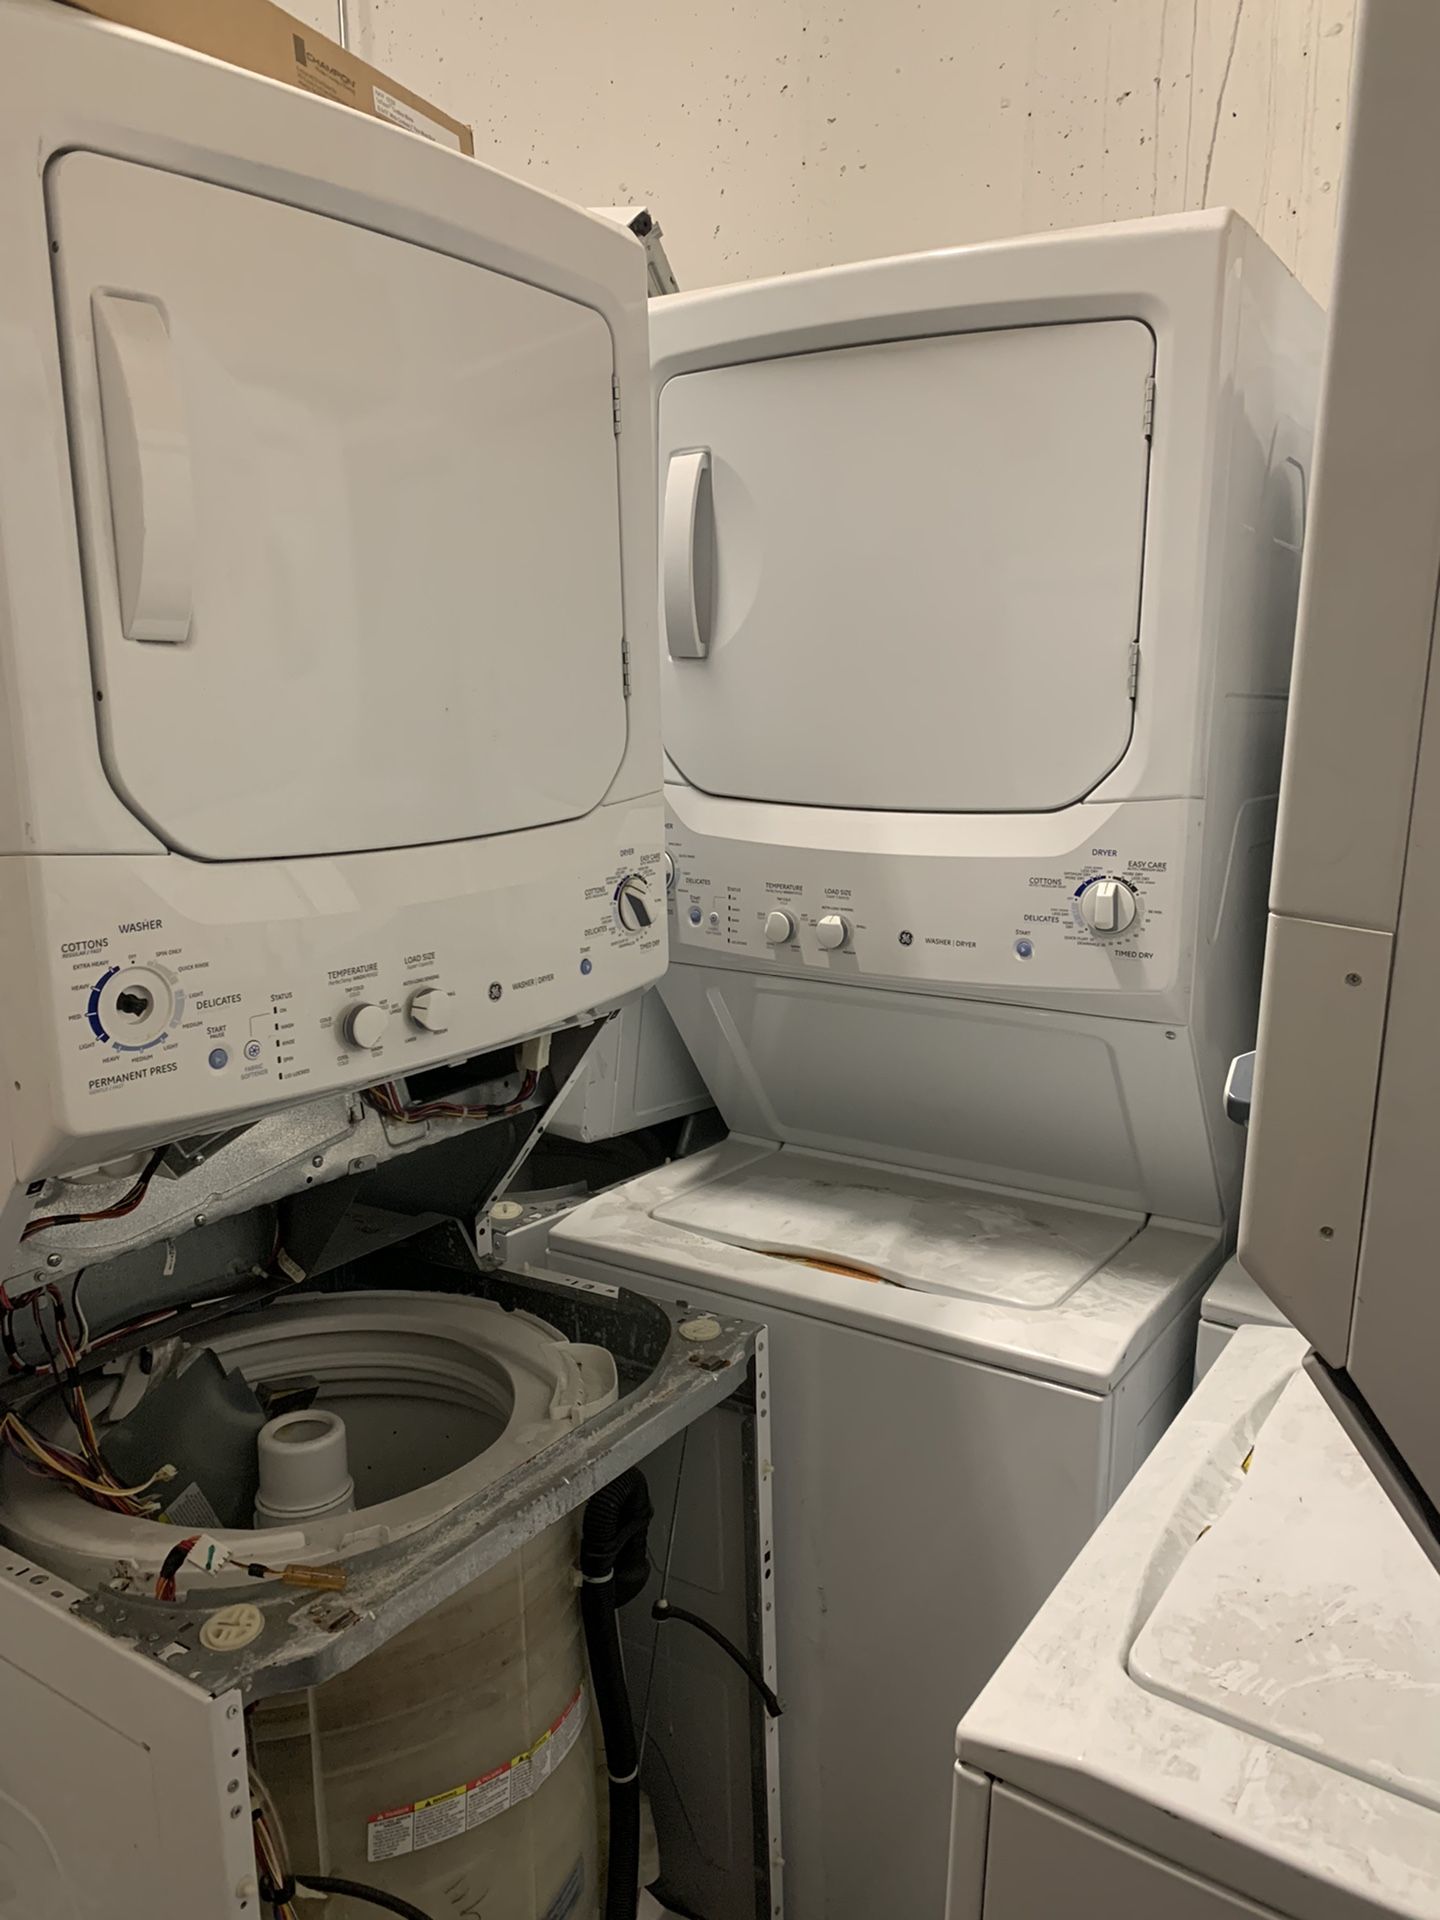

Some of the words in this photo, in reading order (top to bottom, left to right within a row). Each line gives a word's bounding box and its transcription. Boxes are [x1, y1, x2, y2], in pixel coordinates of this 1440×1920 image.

[1092, 848, 1118, 857] DRYER
[1128, 860, 1147, 868] EASY
[1147, 861, 1167, 869] CARE
[1029, 877, 1062, 886] COTTONS
[765, 882, 803, 892] TEMPERATURE
[824, 888, 839, 896] LOAD
[1023, 914, 1060, 924] DELICATES
[118, 919, 163, 934] WASHER
[1015, 929, 1031, 937] START
[61, 938, 109, 953] COTTONS
[925, 937, 951, 946] WASHER
[956, 940, 977, 948] DRYER
[403, 954, 422, 965] LOAD
[422, 951, 435, 961] SIZE
[1114, 949, 1137, 959] TIMED
[1138, 952, 1154, 960] DRY
[328, 962, 378, 980] TEMPERATURE
[511, 978, 535, 990] WASHER
[196, 993, 242, 1010] DELICATES
[270, 992, 293, 1002] STATUS
[206, 1025, 226, 1035] START
[88, 1069, 147, 1090] PERMANENT
[149, 1062, 178, 1077] PRESS
